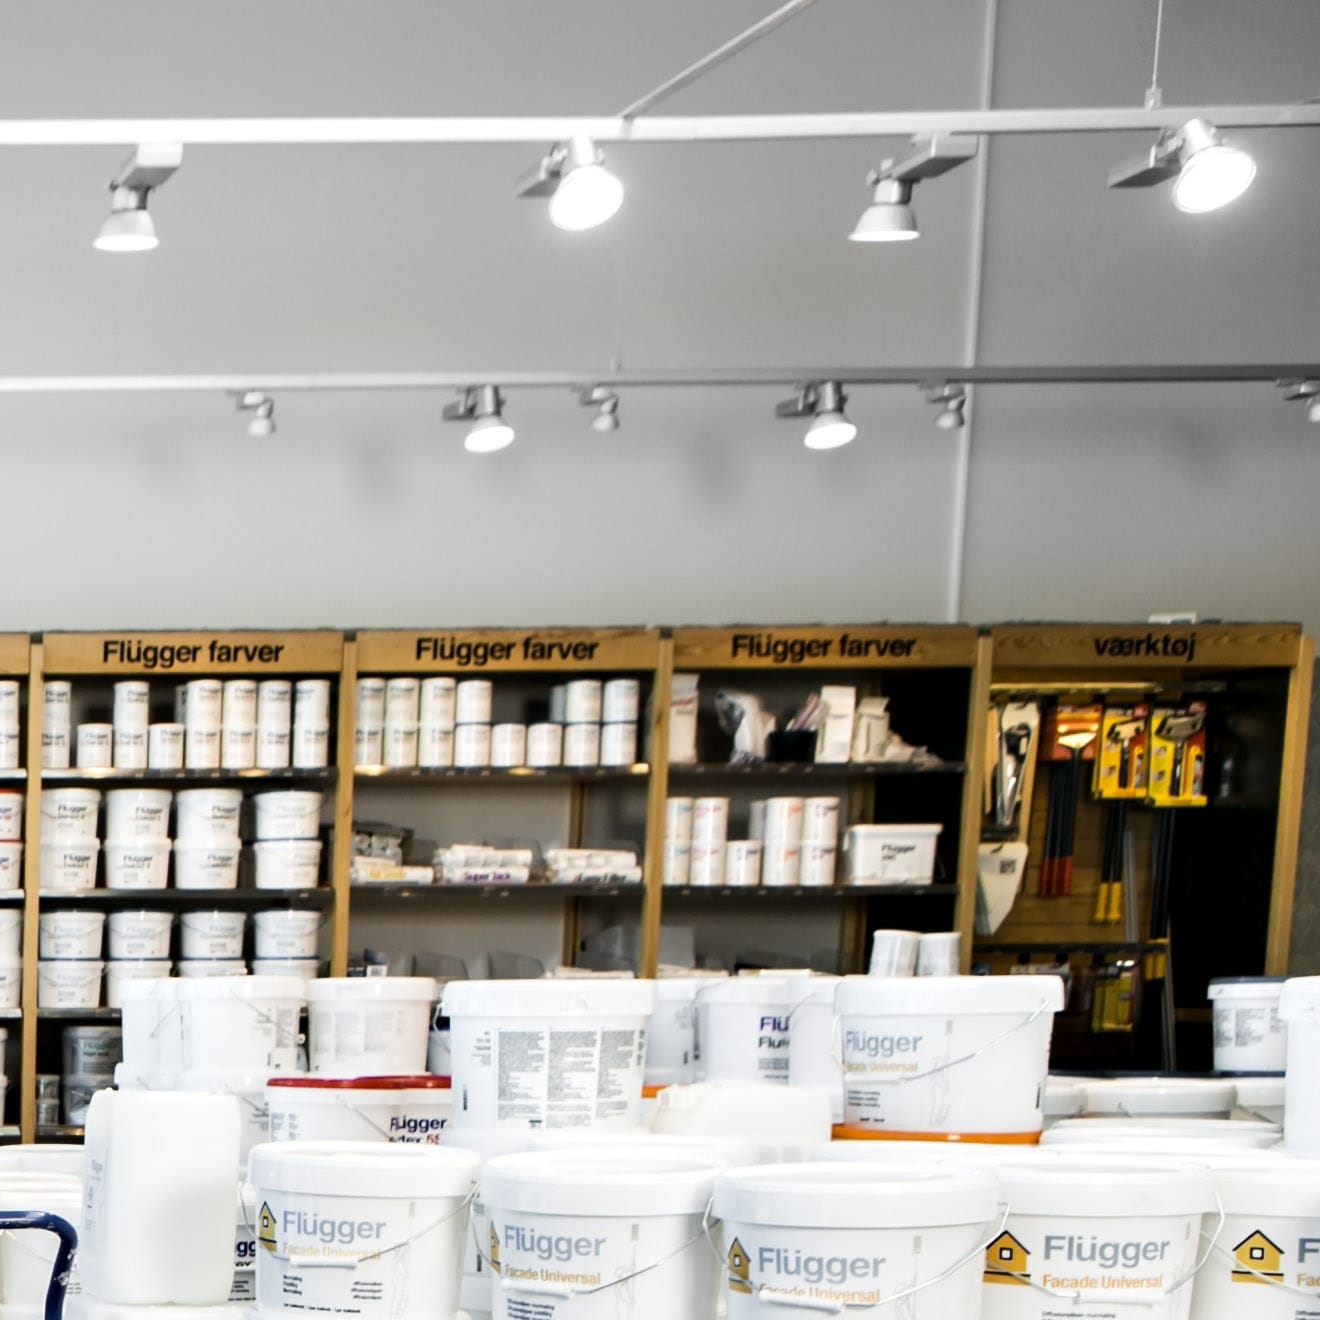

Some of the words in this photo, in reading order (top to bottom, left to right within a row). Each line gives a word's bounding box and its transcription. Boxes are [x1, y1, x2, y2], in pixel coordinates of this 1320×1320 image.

[102, 640, 204, 667] Flügger
[209, 639, 284, 663] farver
[416, 638, 518, 665] Flügger
[523, 637, 598, 660] farver
[730, 634, 833, 661] Flügger
[841, 633, 916, 657] farver
[1093, 631, 1197, 662] værktøj
[846, 1031, 923, 1058] Flügger
[282, 1210, 387, 1244] Flügger
[503, 1224, 606, 1262] Flügger
[1044, 1235, 1170, 1269] Flügger
[540, 1270, 601, 1285] Universal
[757, 1247, 886, 1284] Flügger
[1042, 1274, 1098, 1290] Facade
[1101, 1274, 1163, 1289] Universal
